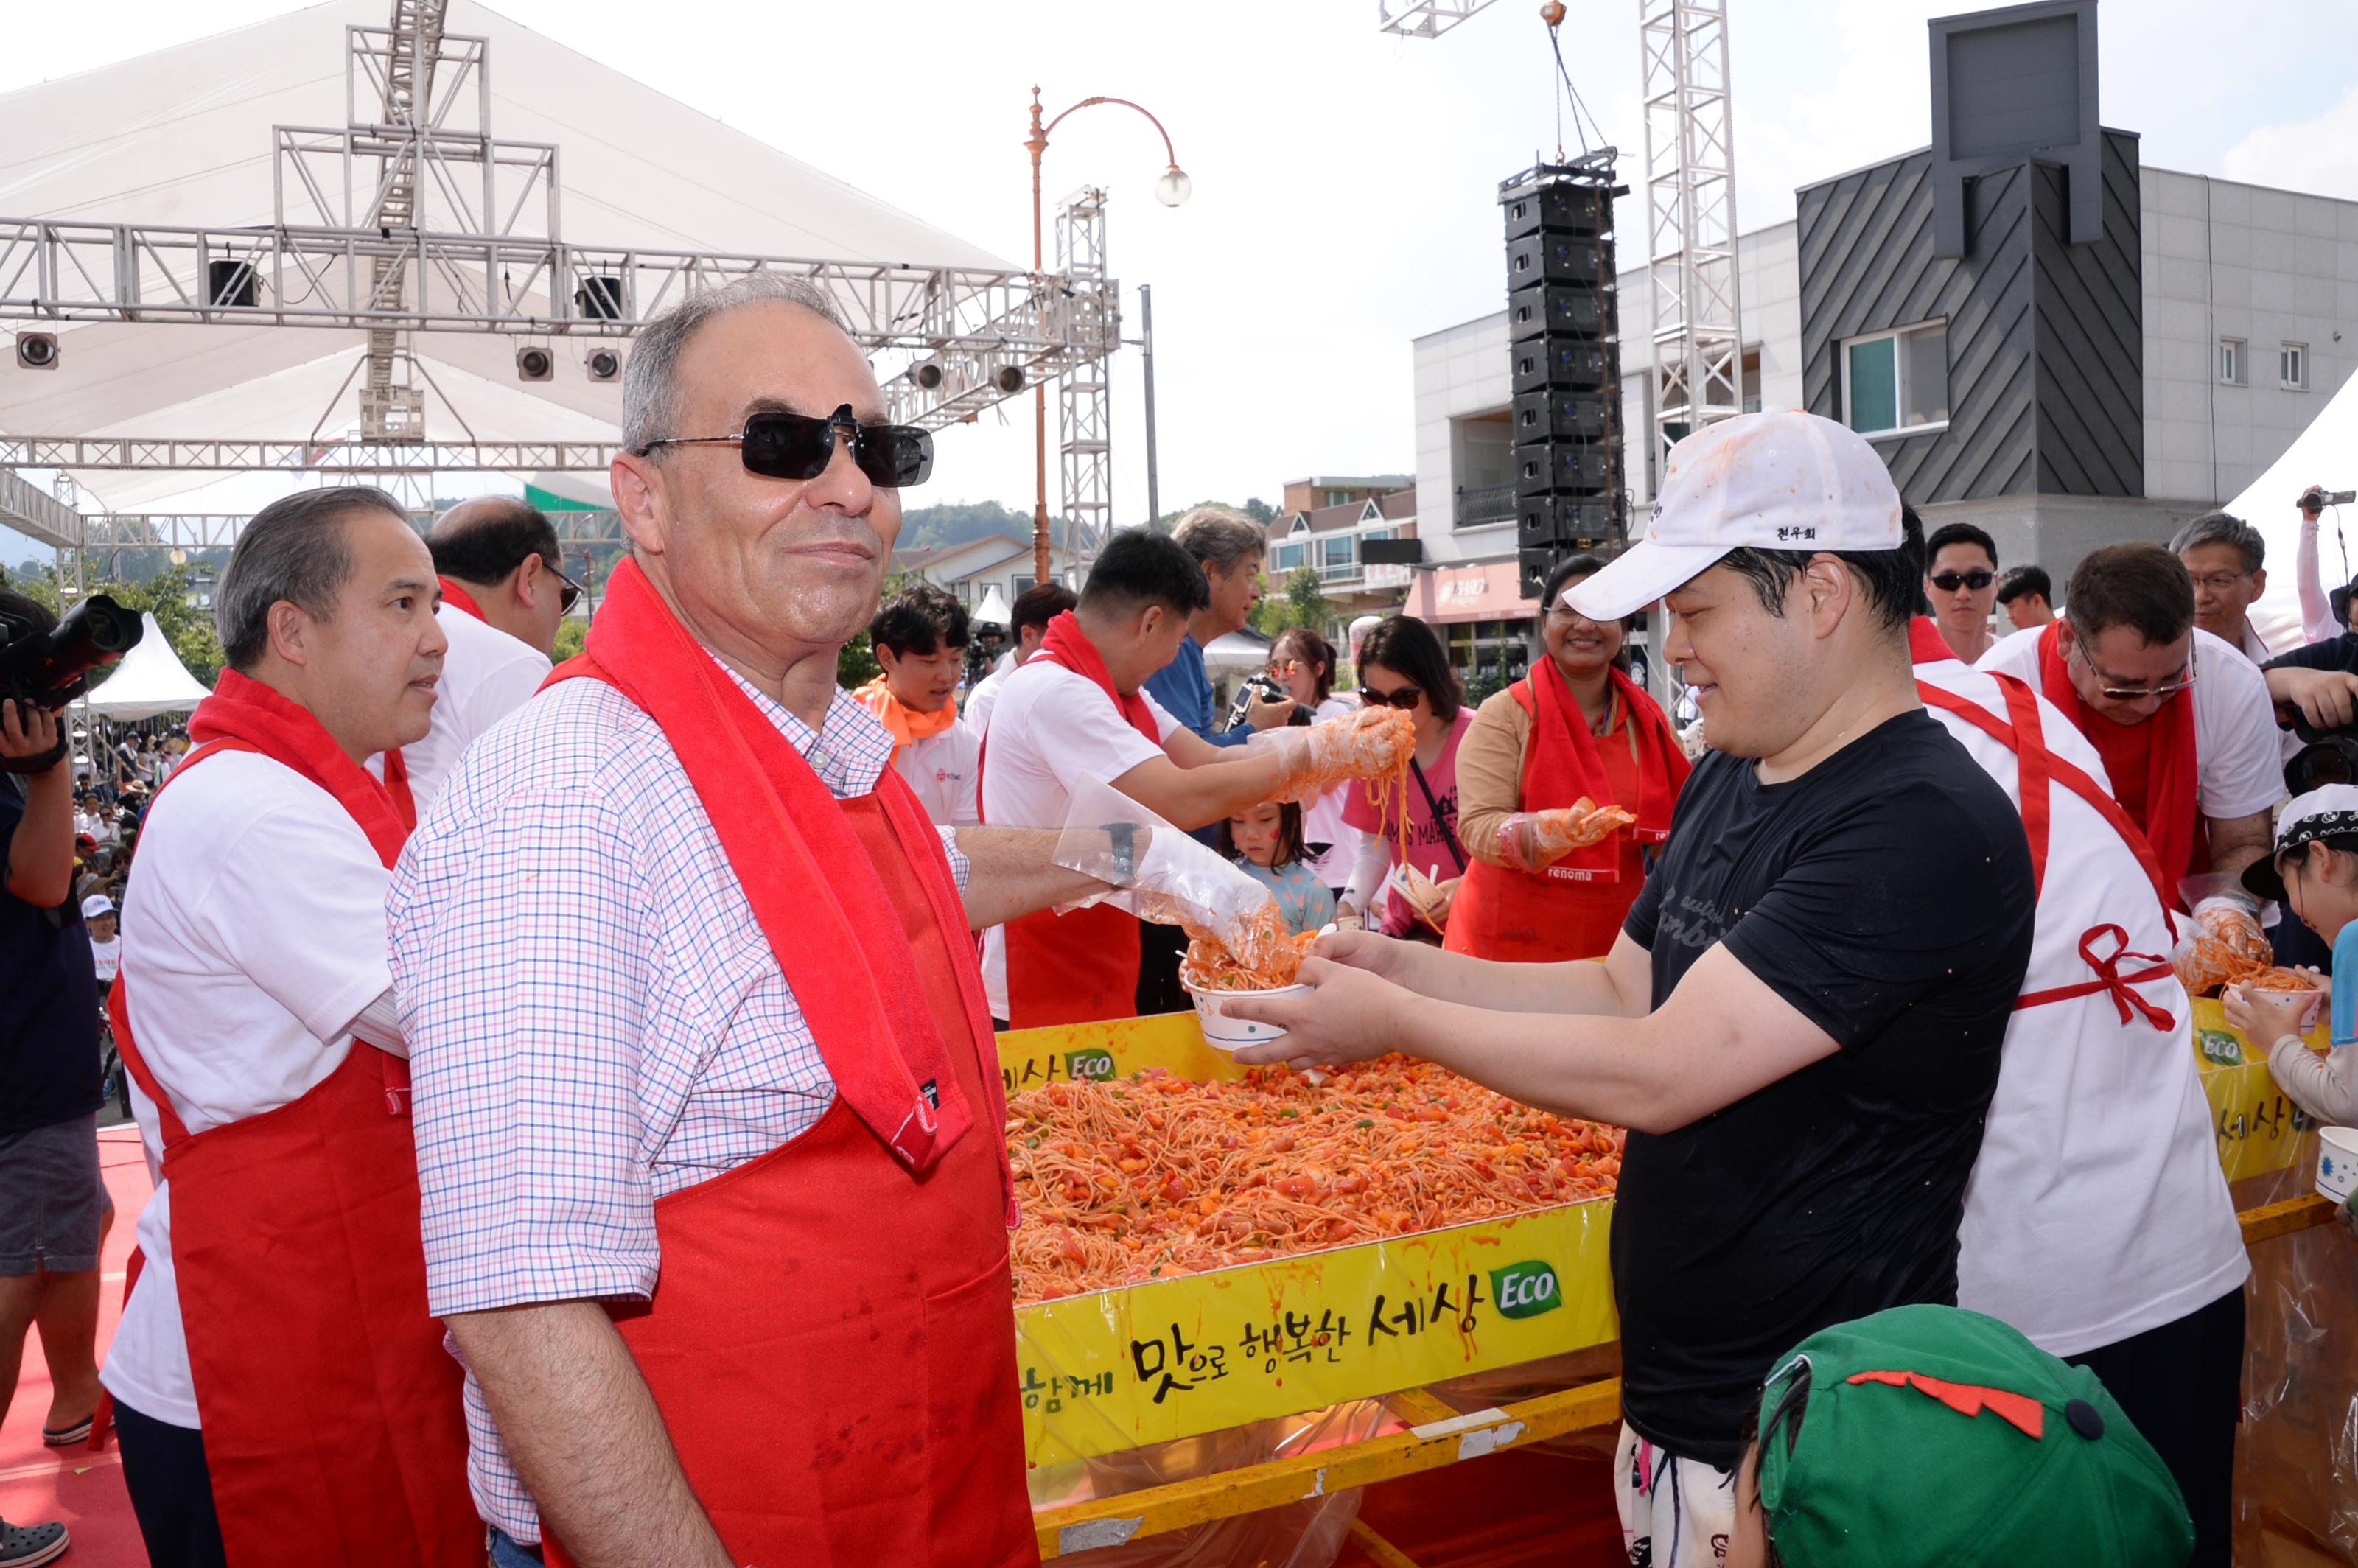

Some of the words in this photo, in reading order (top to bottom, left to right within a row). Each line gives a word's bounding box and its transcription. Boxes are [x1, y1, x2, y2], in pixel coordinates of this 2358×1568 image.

[1548, 868, 1592, 881] renoma
[1021, 1367, 1113, 1413] 함께
[1130, 1323, 1229, 1404] 맛으로
[1239, 1309, 1351, 1374] 행복한
[1368, 1273, 1485, 1347] 세상
